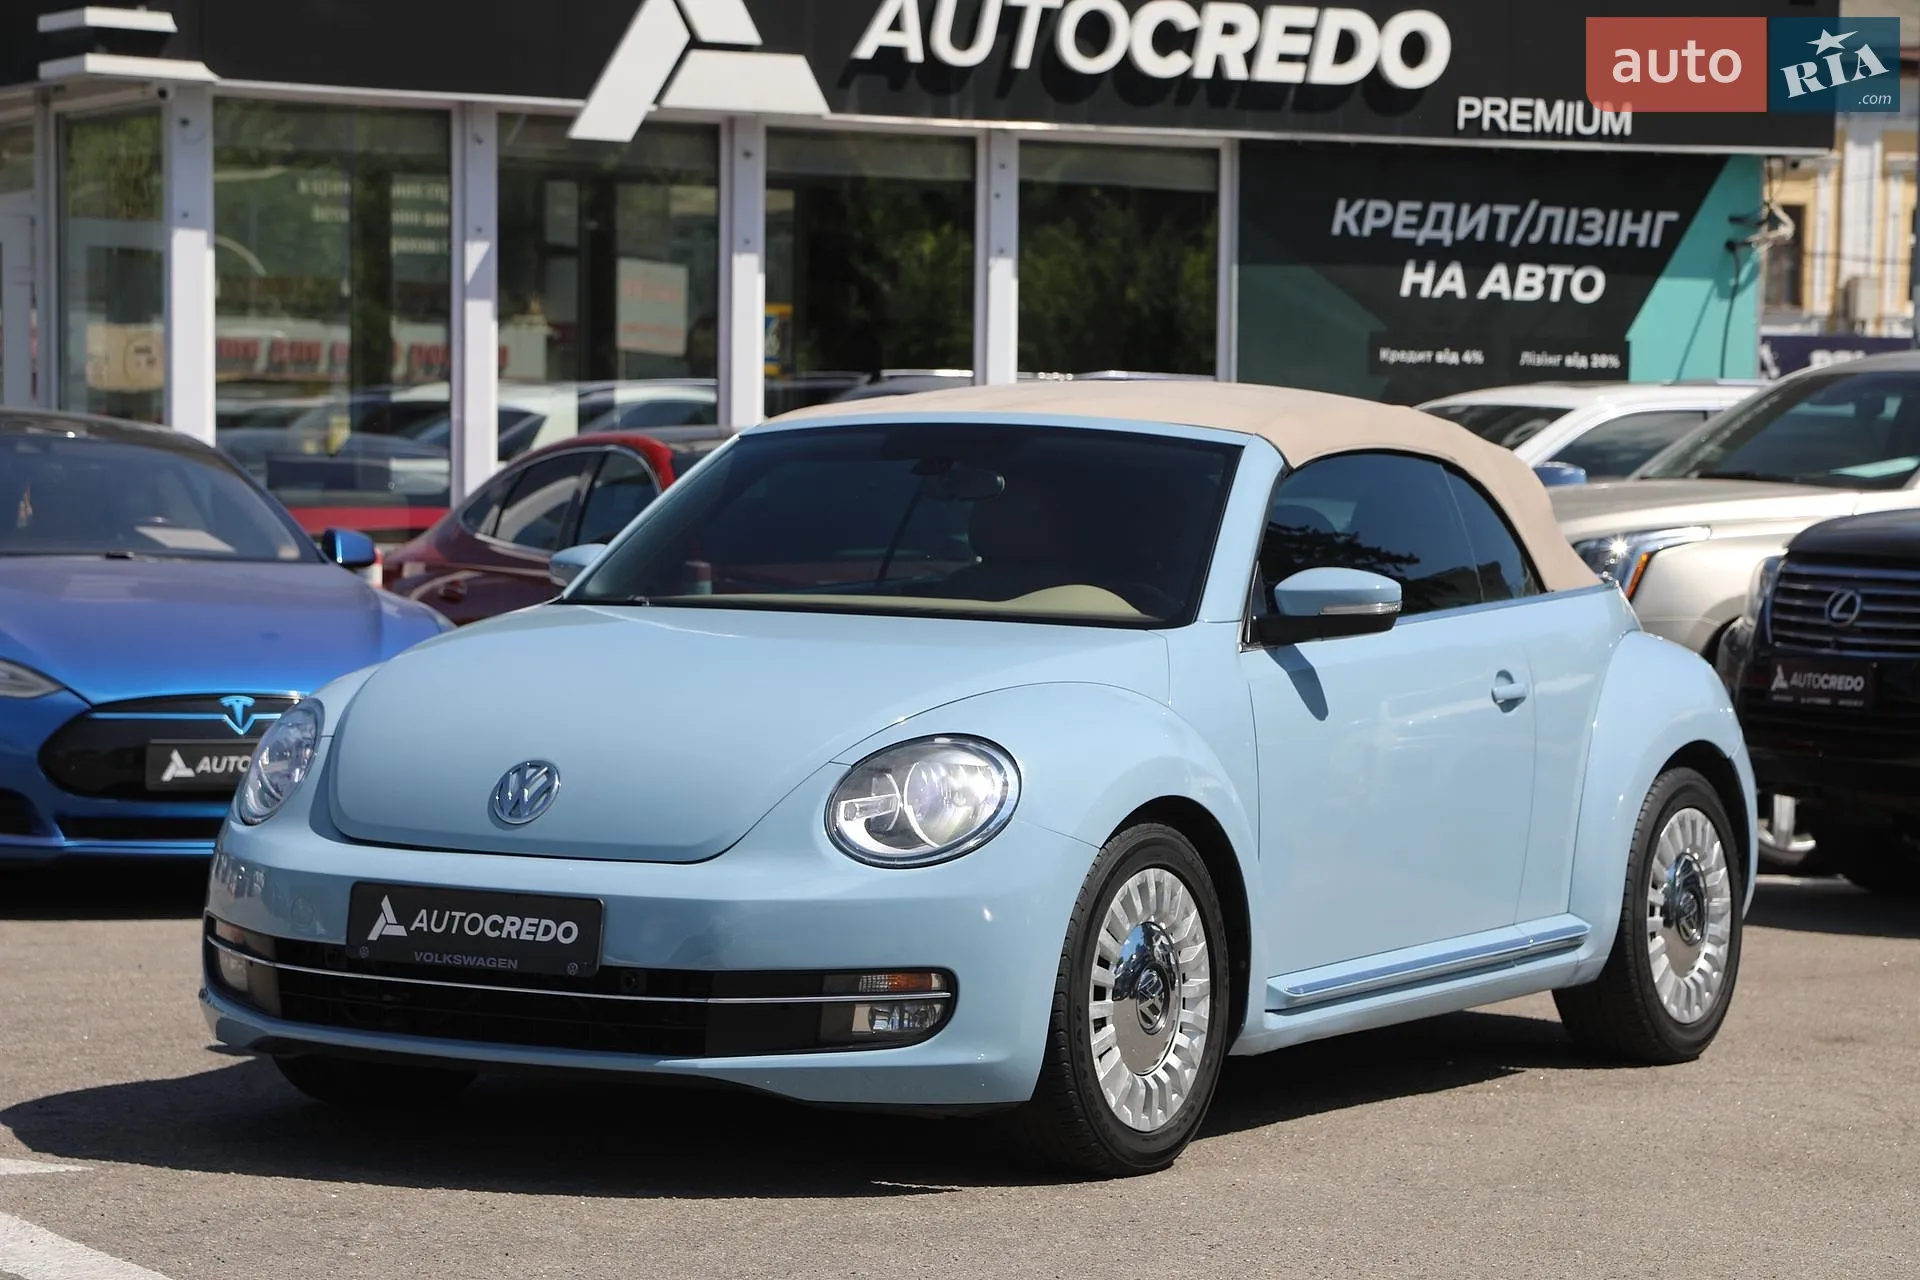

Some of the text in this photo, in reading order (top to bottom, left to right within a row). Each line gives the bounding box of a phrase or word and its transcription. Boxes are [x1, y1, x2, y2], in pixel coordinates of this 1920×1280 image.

[851, 0, 1452, 90] AUTOCREDO
[1457, 96, 1633, 136] PREMIUM
[1331, 199, 1680, 248] КРЕДИТ/ЛІЗІНГ
[1399, 259, 1607, 304] НА АВТО
[1380, 347, 1433, 364] Кредит
[1790, 671, 1865, 692] AUTOCREDO
[410, 908, 579, 944] AUTOCREDO
[414, 951, 518, 969] VOLKSWAGEN
